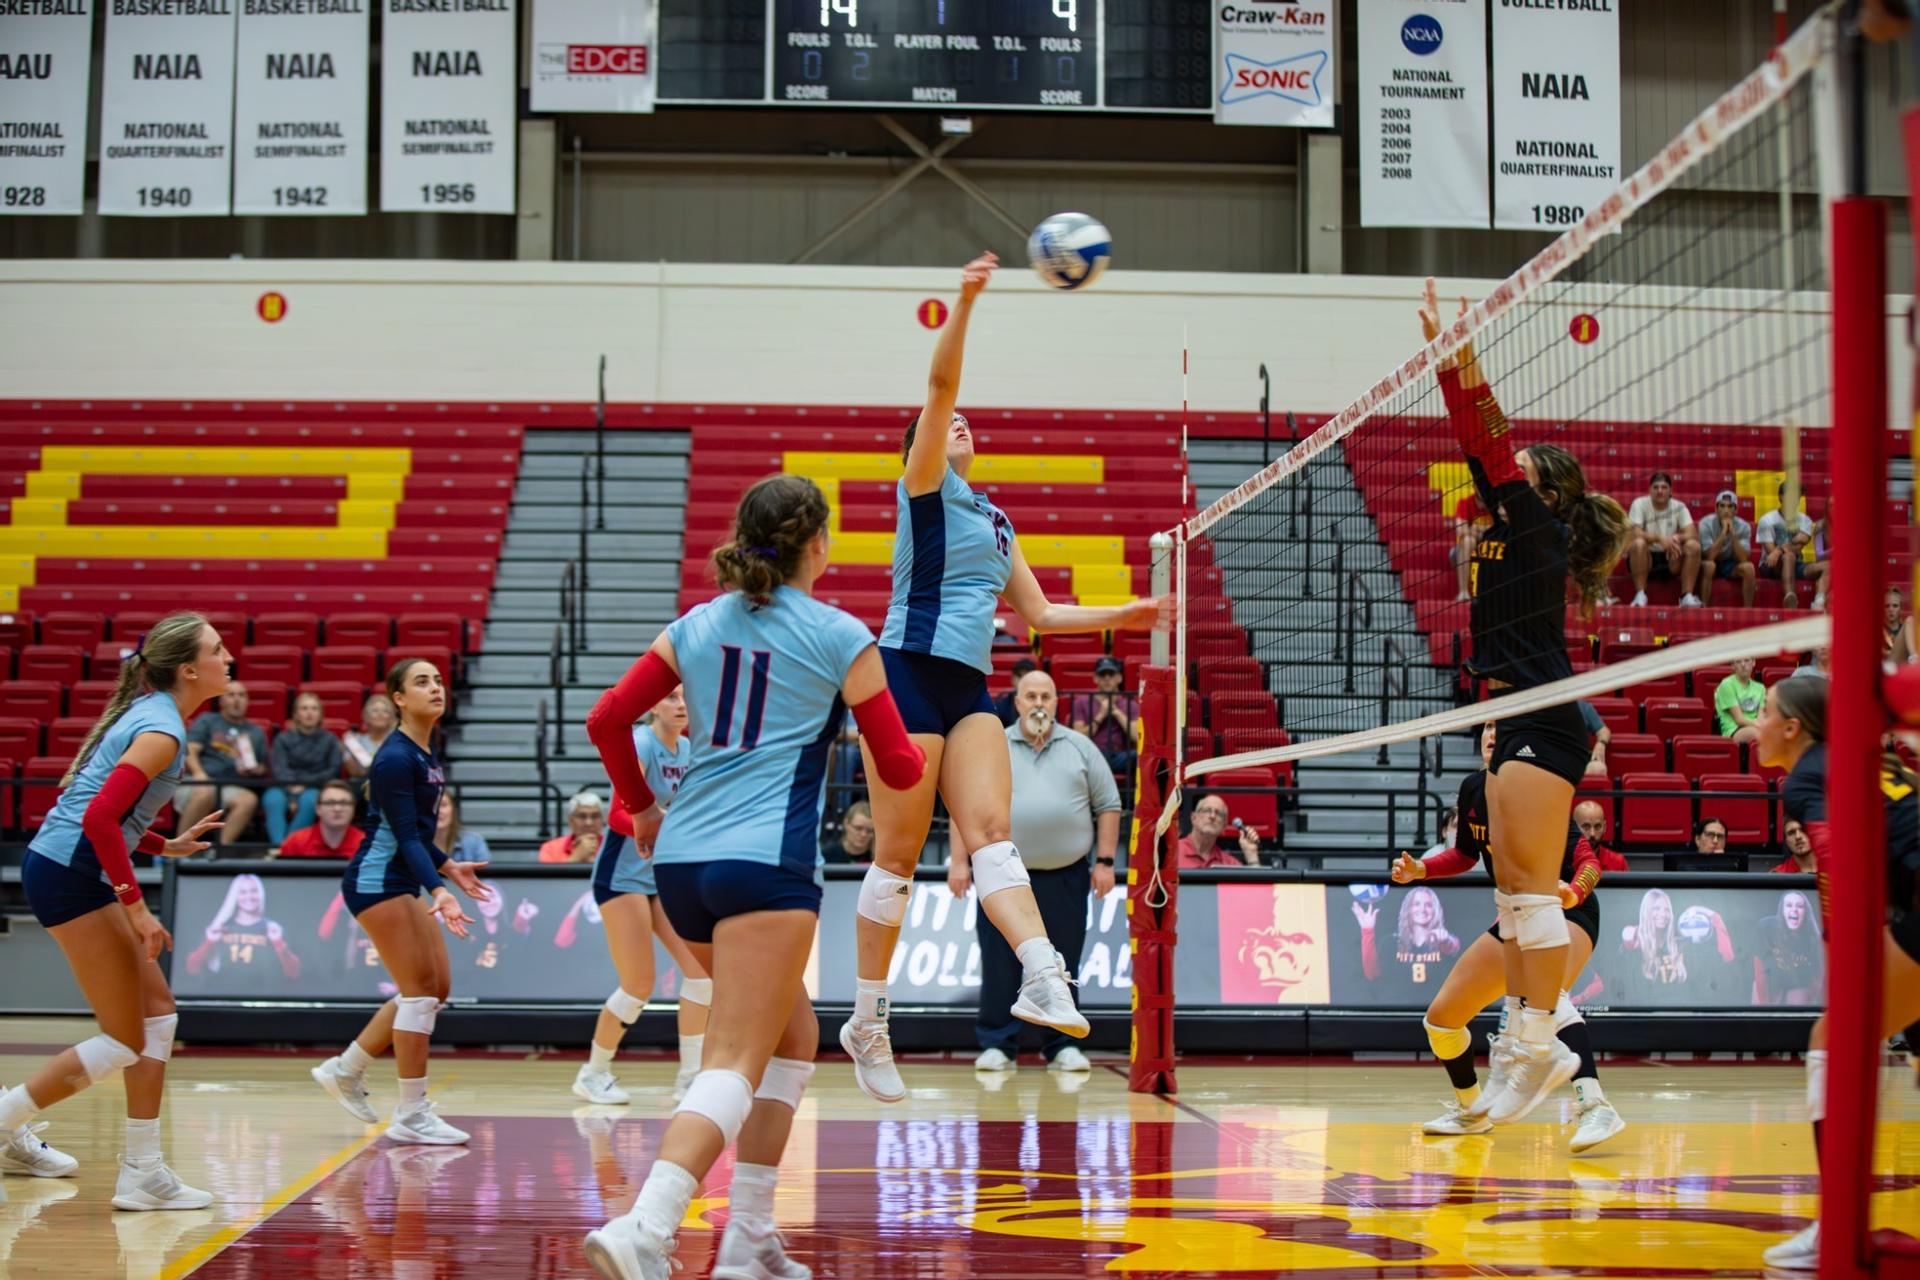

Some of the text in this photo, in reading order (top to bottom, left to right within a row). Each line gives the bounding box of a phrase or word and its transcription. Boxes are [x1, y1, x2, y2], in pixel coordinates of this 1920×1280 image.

[0, 0, 87, 16] SKETBALL
[113, 0, 231, 16] BASKETBALL
[244, 0, 363, 15] BASKETBALL
[1221, 5, 1325, 26] Craw-Kan
[788, 32, 830, 48] FOULS
[895, 34, 981, 51] PLAYER FOUL
[1040, 37, 1082, 53] FOULS
[133, 54, 202, 80] NAIA
[266, 53, 336, 80] NAIA
[412, 51, 483, 77] NAIA
[568, 47, 645, 72] EDGE
[1235, 69, 1311, 90] SONIC
[1392, 69, 1454, 83] NATIONAL
[786, 85, 829, 100] SCORE
[1380, 85, 1466, 100] TOURNAMENT
[1522, 72, 1590, 101] NAIA
[912, 87, 957, 103] MATCH
[1040, 90, 1082, 105] SCORE
[1380, 108, 1411, 120] 2003
[124, 123, 209, 139] NATIONAL
[257, 122, 343, 139] NATIONAL
[404, 120, 491, 137] NATIONAL
[1381, 123, 1411, 135] 2004
[106, 145, 225, 159] QUARTERFINALIST
[254, 144, 347, 159] SEMIFINALIST
[401, 141, 494, 156] SEMIFINALIST
[1381, 138, 1412, 150] 2006
[1515, 140, 1599, 159] NATIONAL
[1381, 152, 1412, 164] 2007
[1382, 167, 1412, 179] 2008
[1500, 163, 1615, 179] QUARTERFINALIST
[137, 188, 192, 207] 1940
[273, 187, 328, 207] 1942
[420, 184, 476, 204] 1956
[1531, 205, 1585, 225] 1980
[711, 644, 772, 750] 11
[1412, 963, 1427, 983] 8
